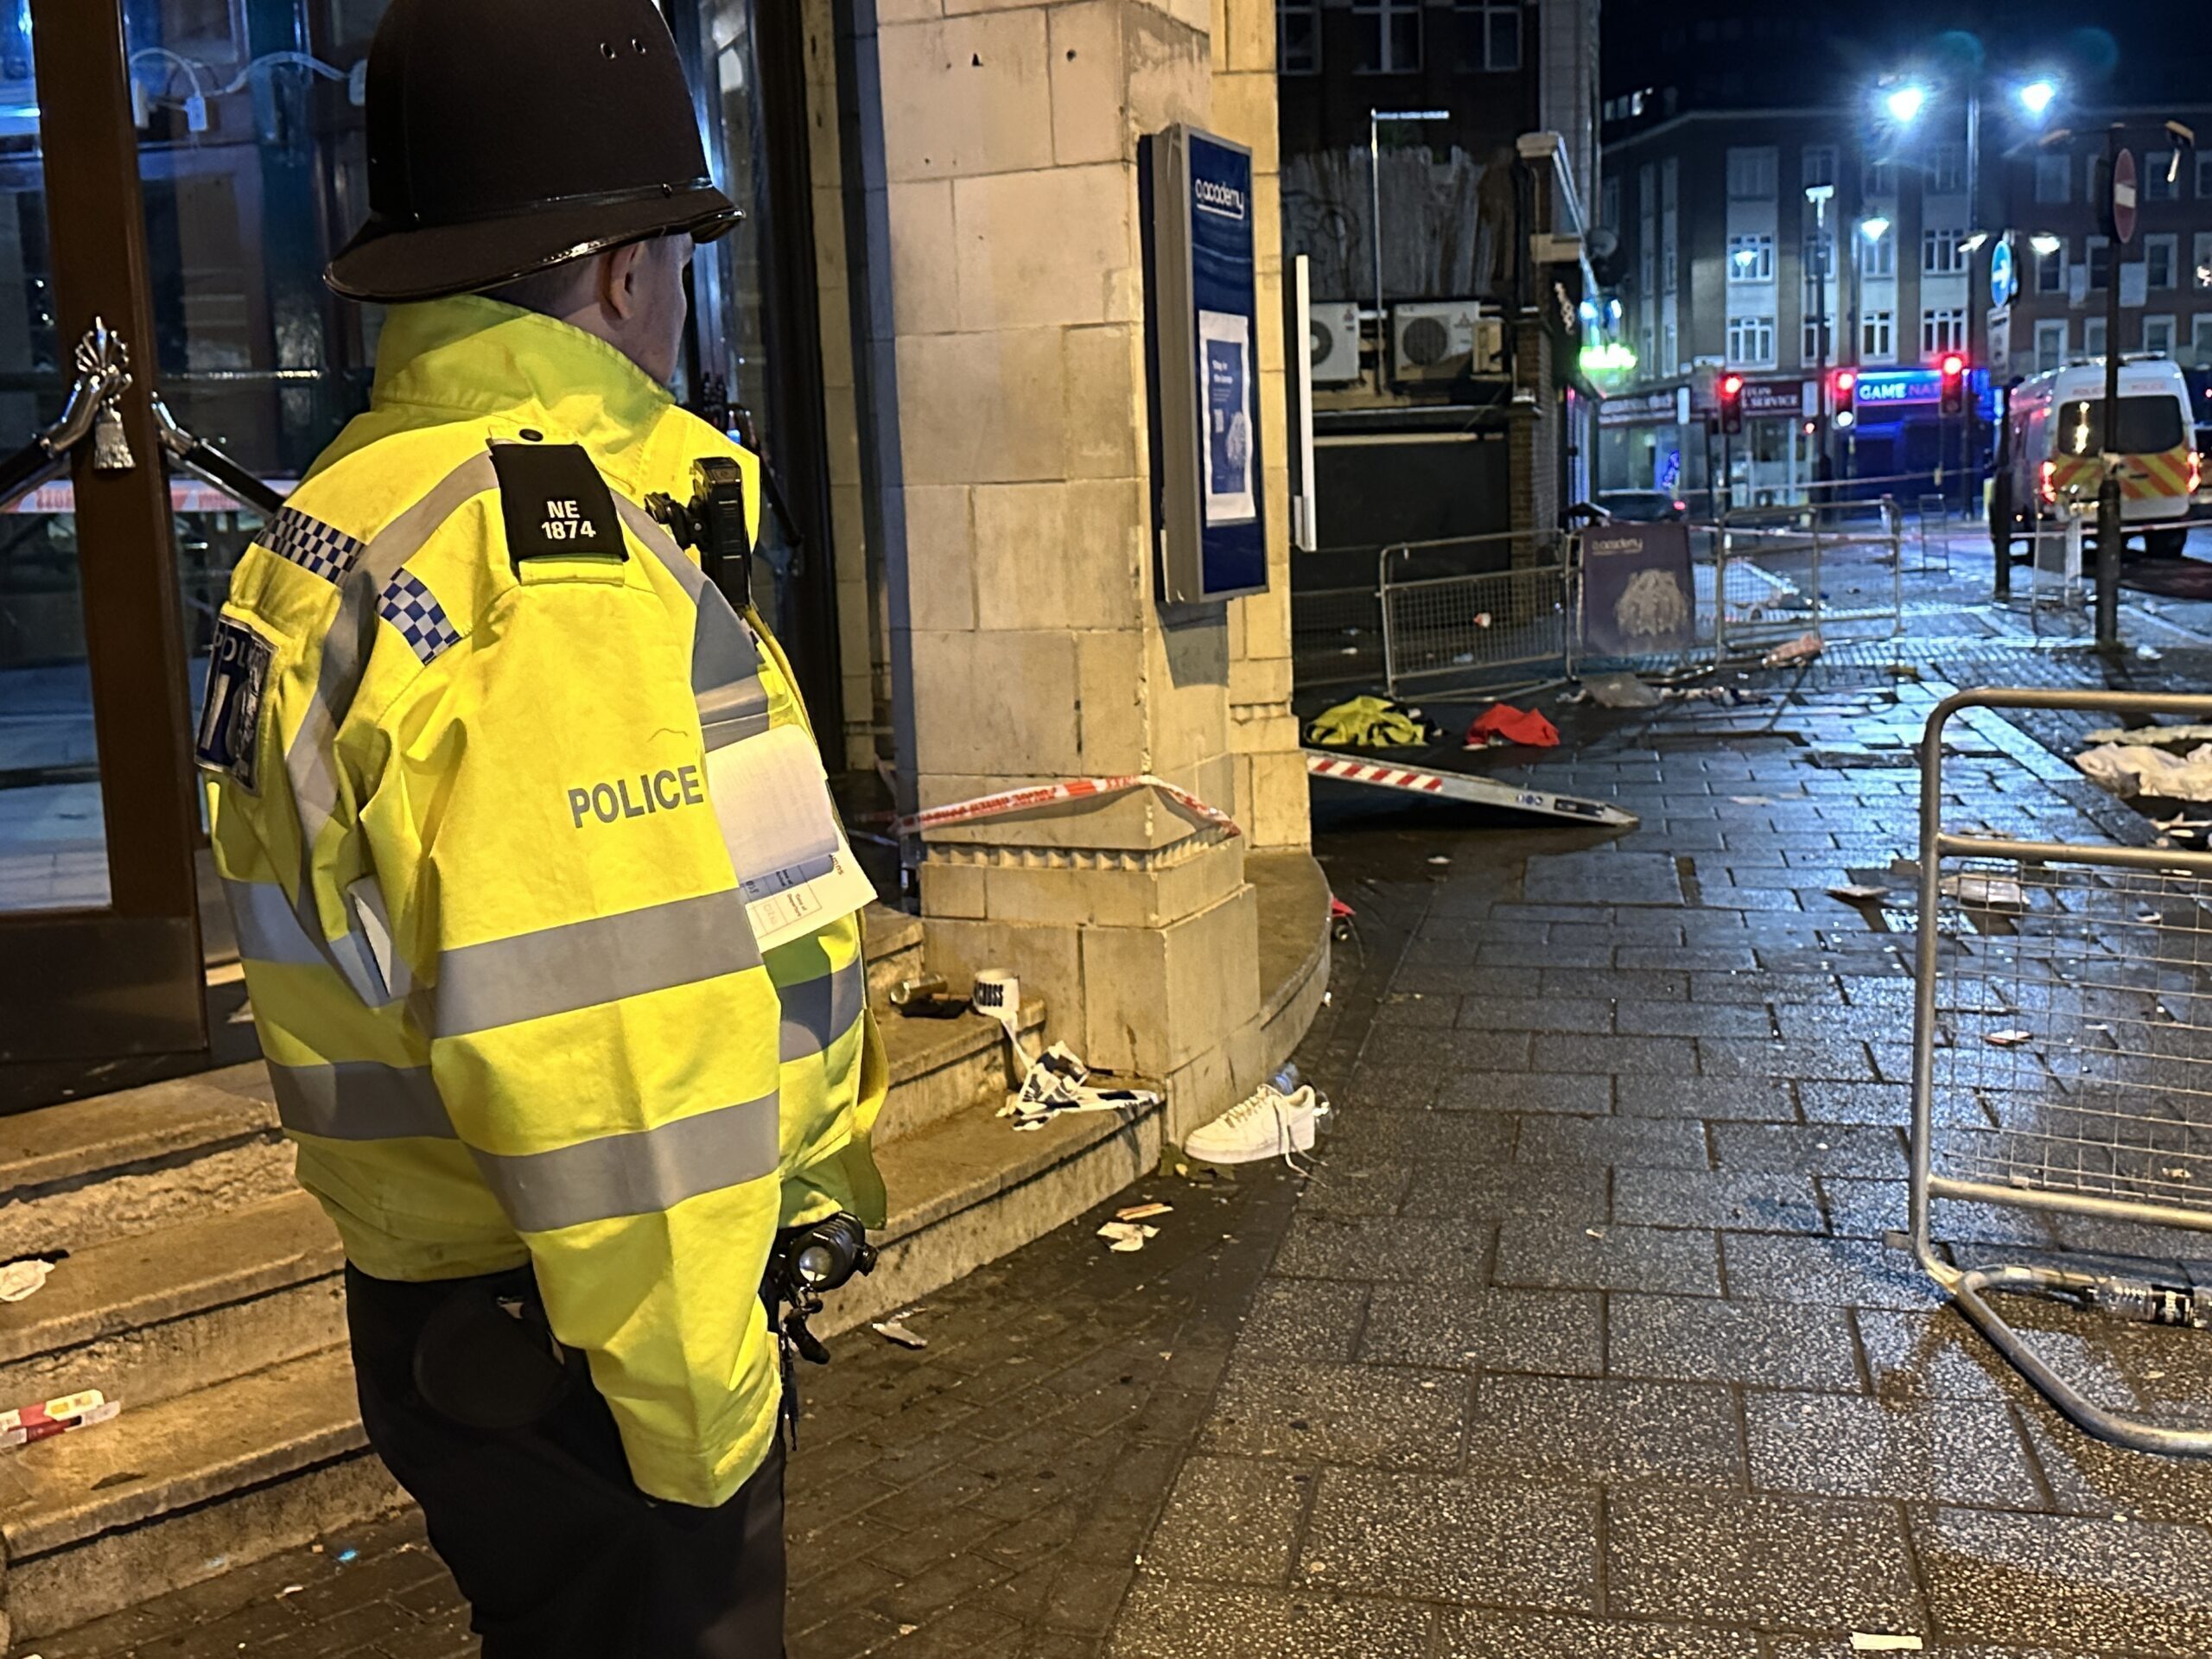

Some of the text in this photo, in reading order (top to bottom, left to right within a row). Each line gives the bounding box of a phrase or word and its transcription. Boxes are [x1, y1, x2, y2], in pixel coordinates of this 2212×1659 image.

[1859, 381, 1942, 400] GAME NAT
[546, 499, 581, 518] NE
[541, 520, 596, 540] 1874
[568, 765, 703, 829] POLICE
